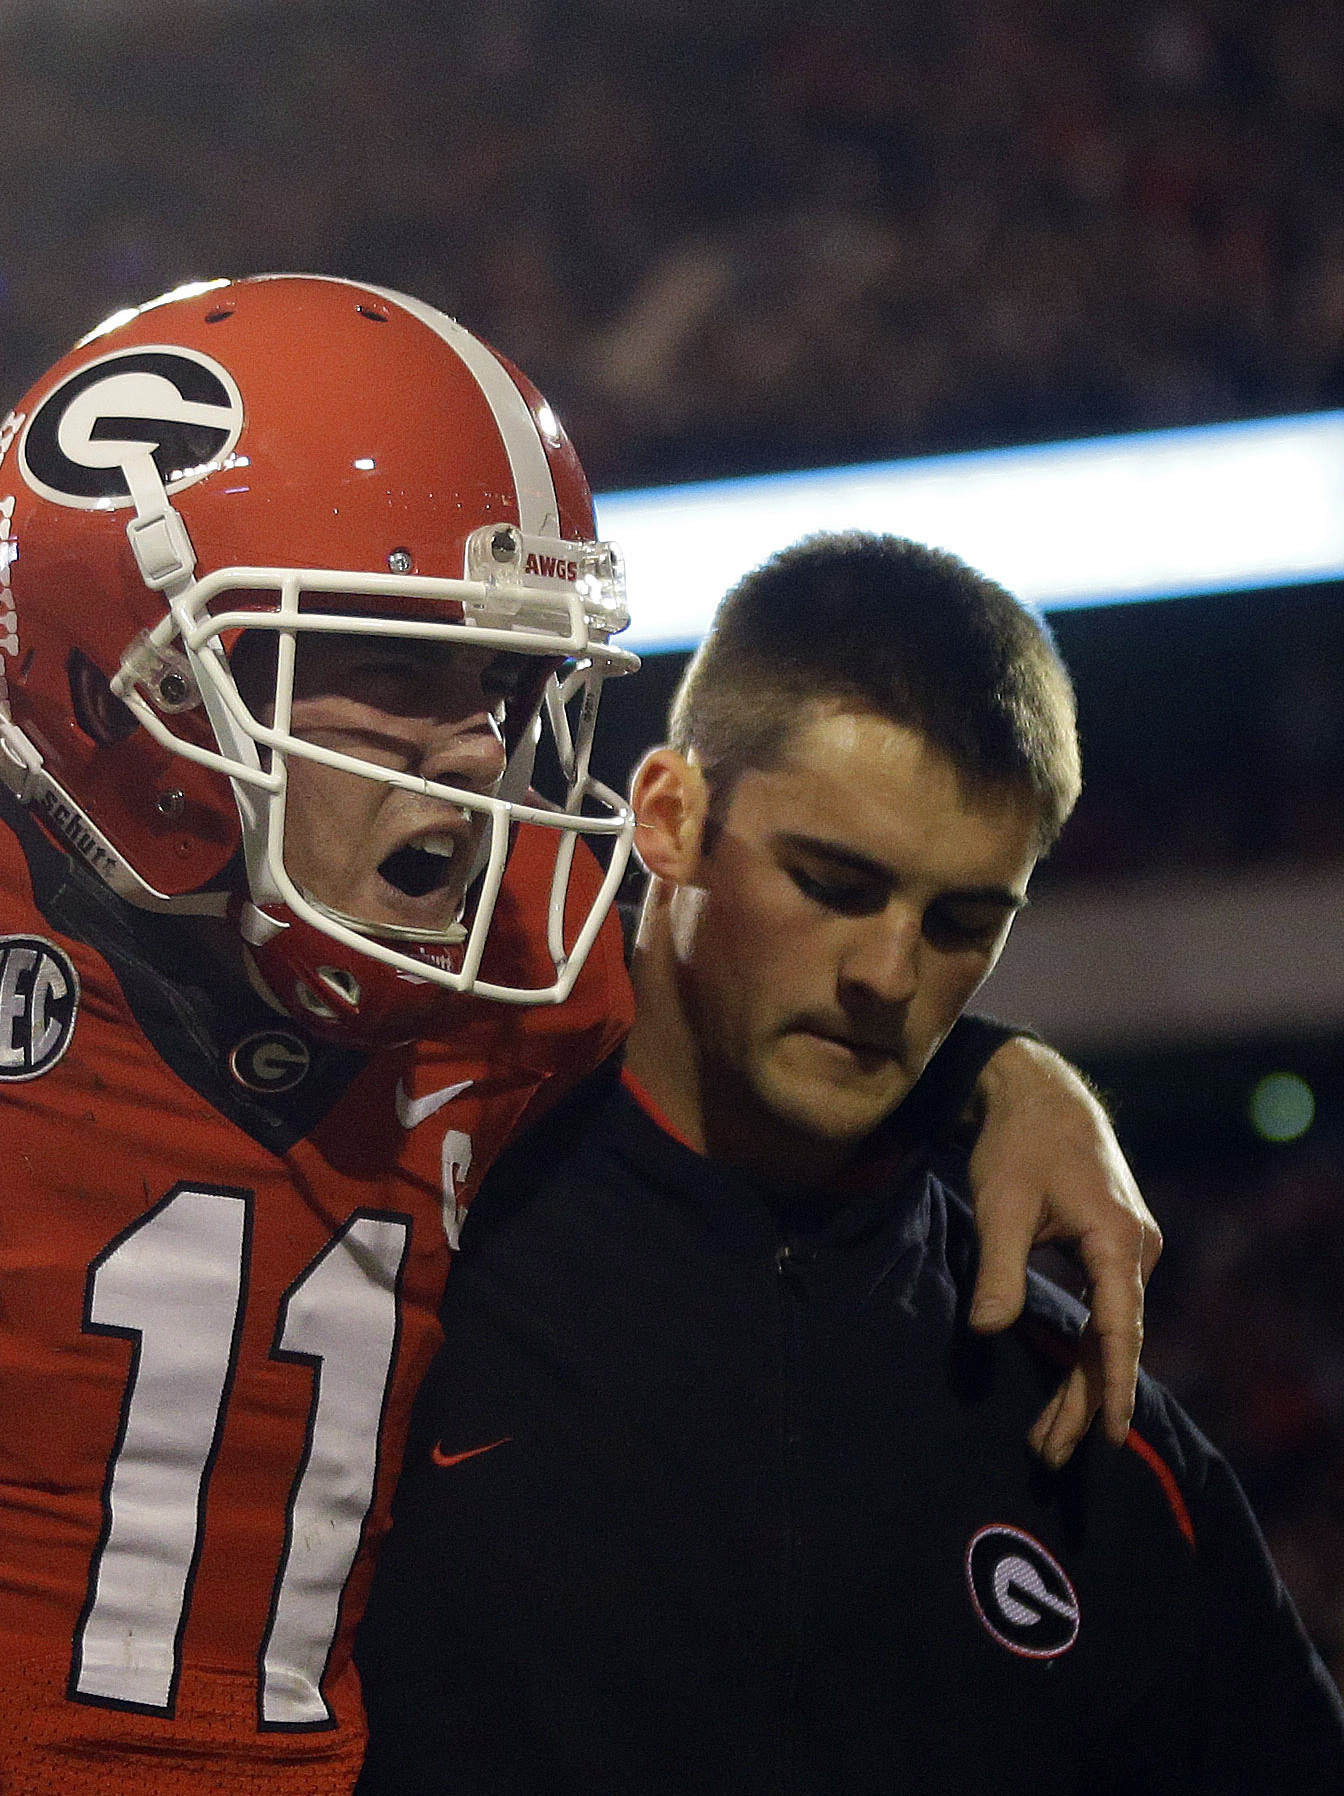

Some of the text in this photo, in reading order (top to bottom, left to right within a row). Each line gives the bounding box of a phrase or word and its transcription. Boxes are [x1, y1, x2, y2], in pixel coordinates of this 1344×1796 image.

[21, 349, 237, 501] G
[524, 552, 578, 582] AWGS
[441, 1128, 473, 1252] C
[67, 1179, 414, 1732] 11
[966, 1524, 1080, 1658] G
